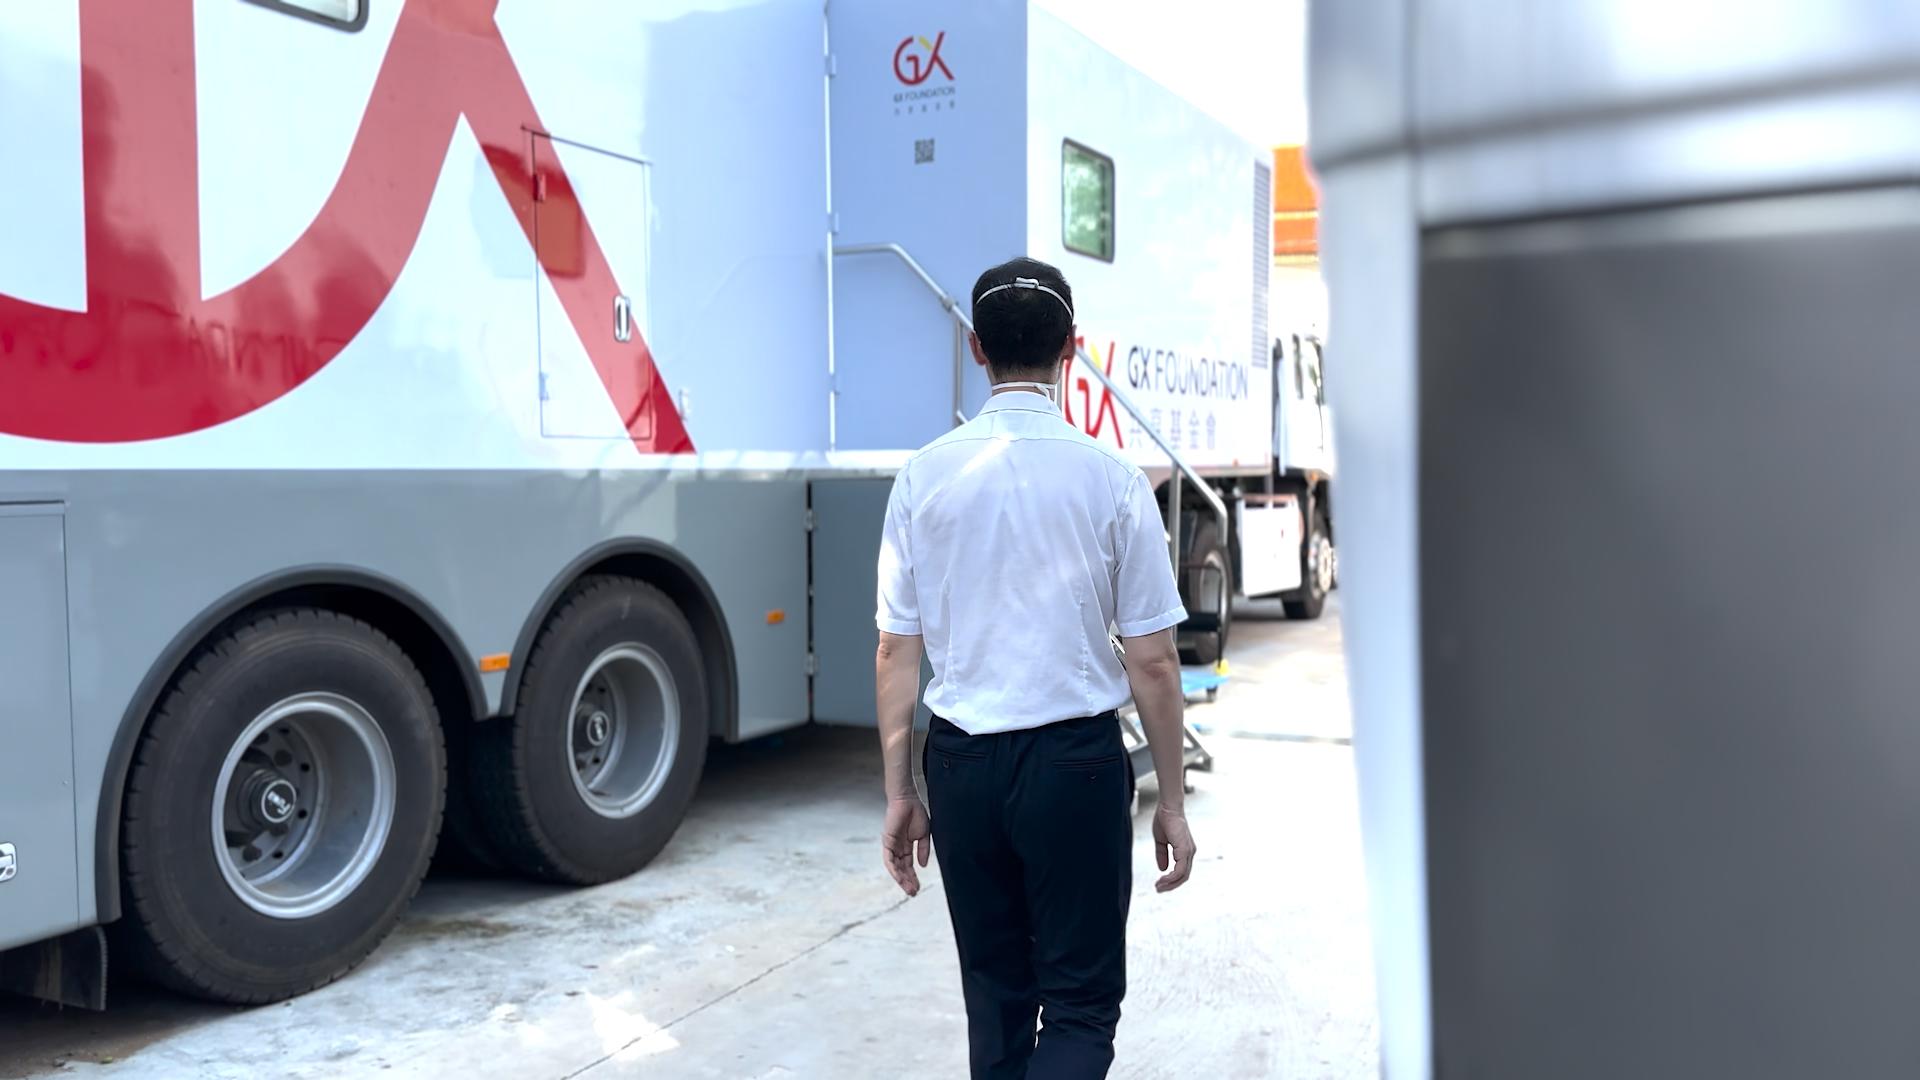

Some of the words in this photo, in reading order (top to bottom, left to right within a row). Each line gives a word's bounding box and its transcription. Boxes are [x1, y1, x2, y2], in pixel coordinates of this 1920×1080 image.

[893, 31, 954, 86] GX
[905, 87, 955, 101] FOUNDATION
[1128, 345, 1150, 389] GX
[1155, 350, 1248, 400] FOUNDATION
